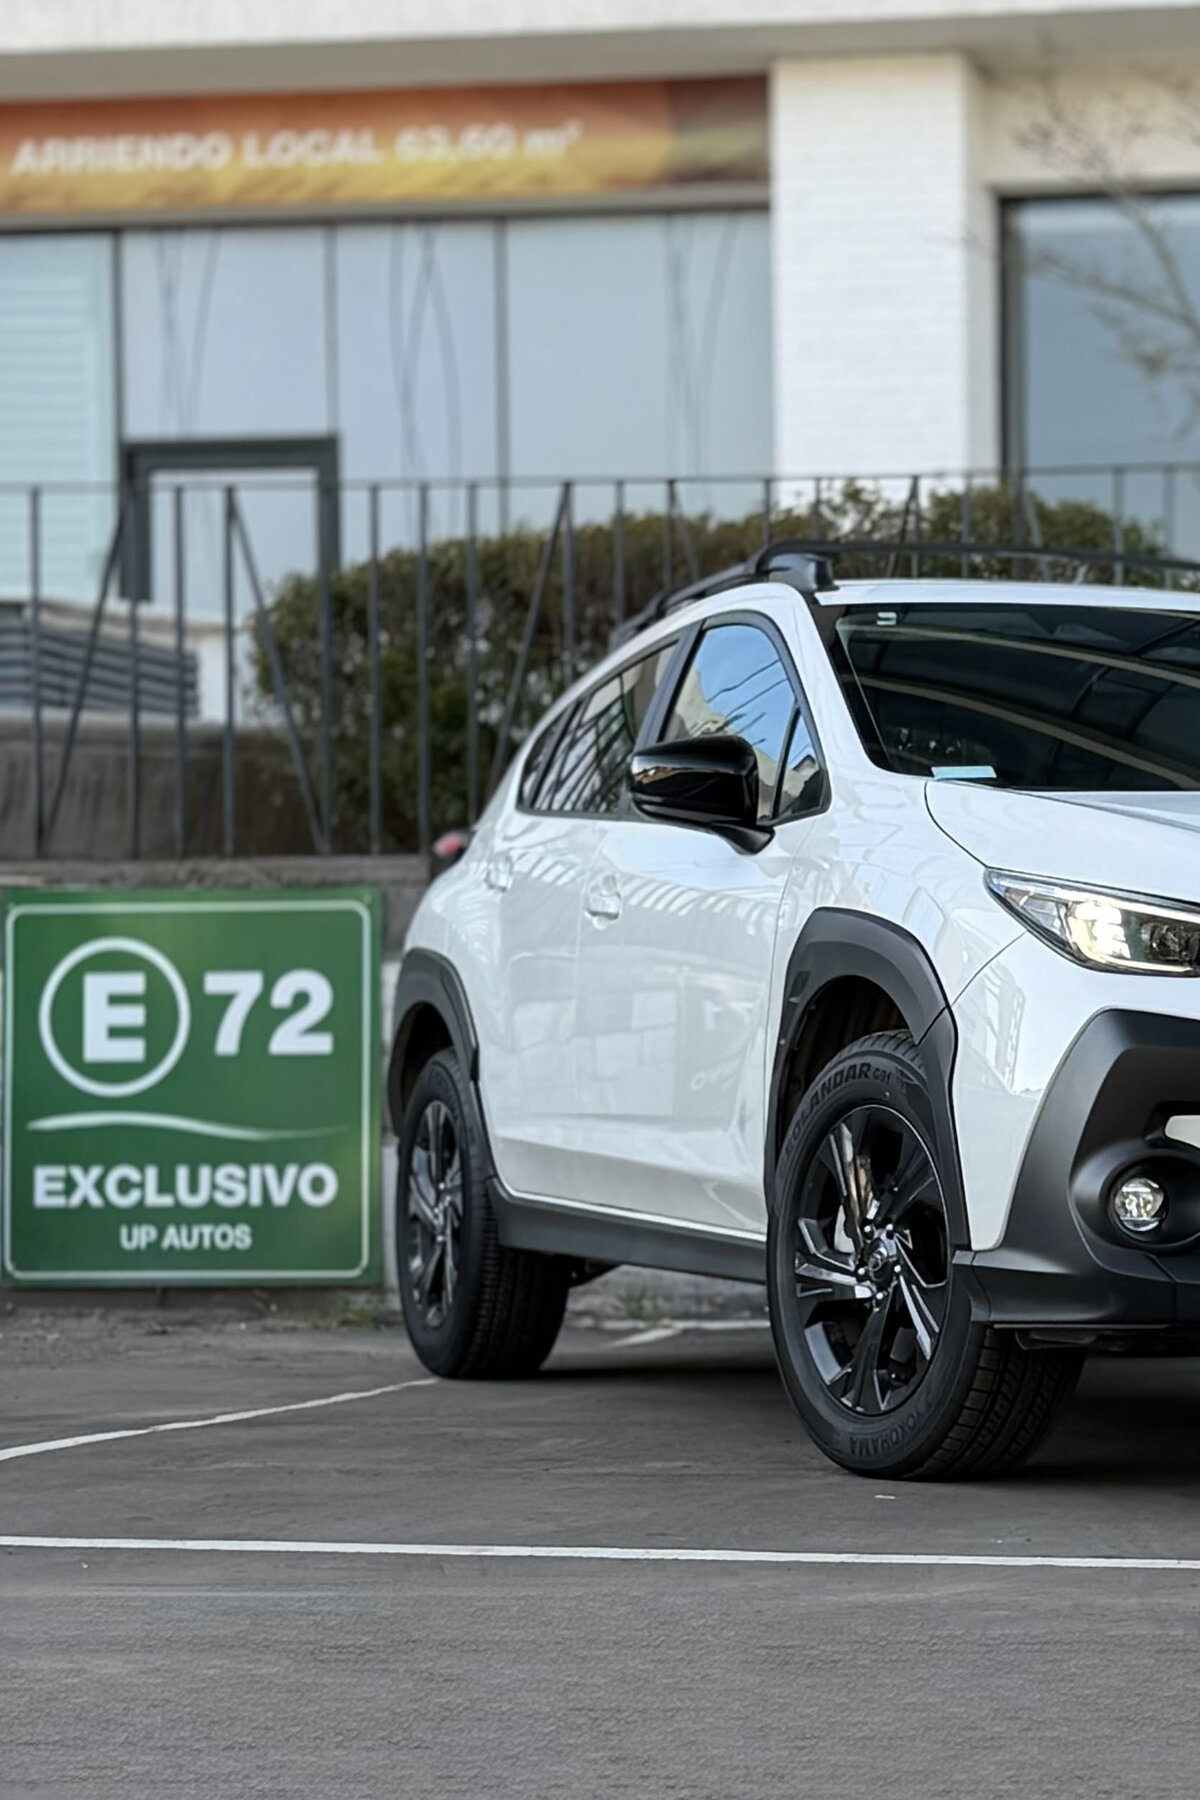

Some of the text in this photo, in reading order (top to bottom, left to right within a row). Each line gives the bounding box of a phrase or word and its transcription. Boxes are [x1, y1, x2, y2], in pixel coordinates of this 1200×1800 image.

[12, 132, 234, 176] ARRIENDO
[243, 127, 382, 169] LOCAL
[83, 968, 335, 1063] E 72
[33, 1162, 339, 1209] EXCLUSIVO
[120, 1223, 253, 1251] UP AUTOS
